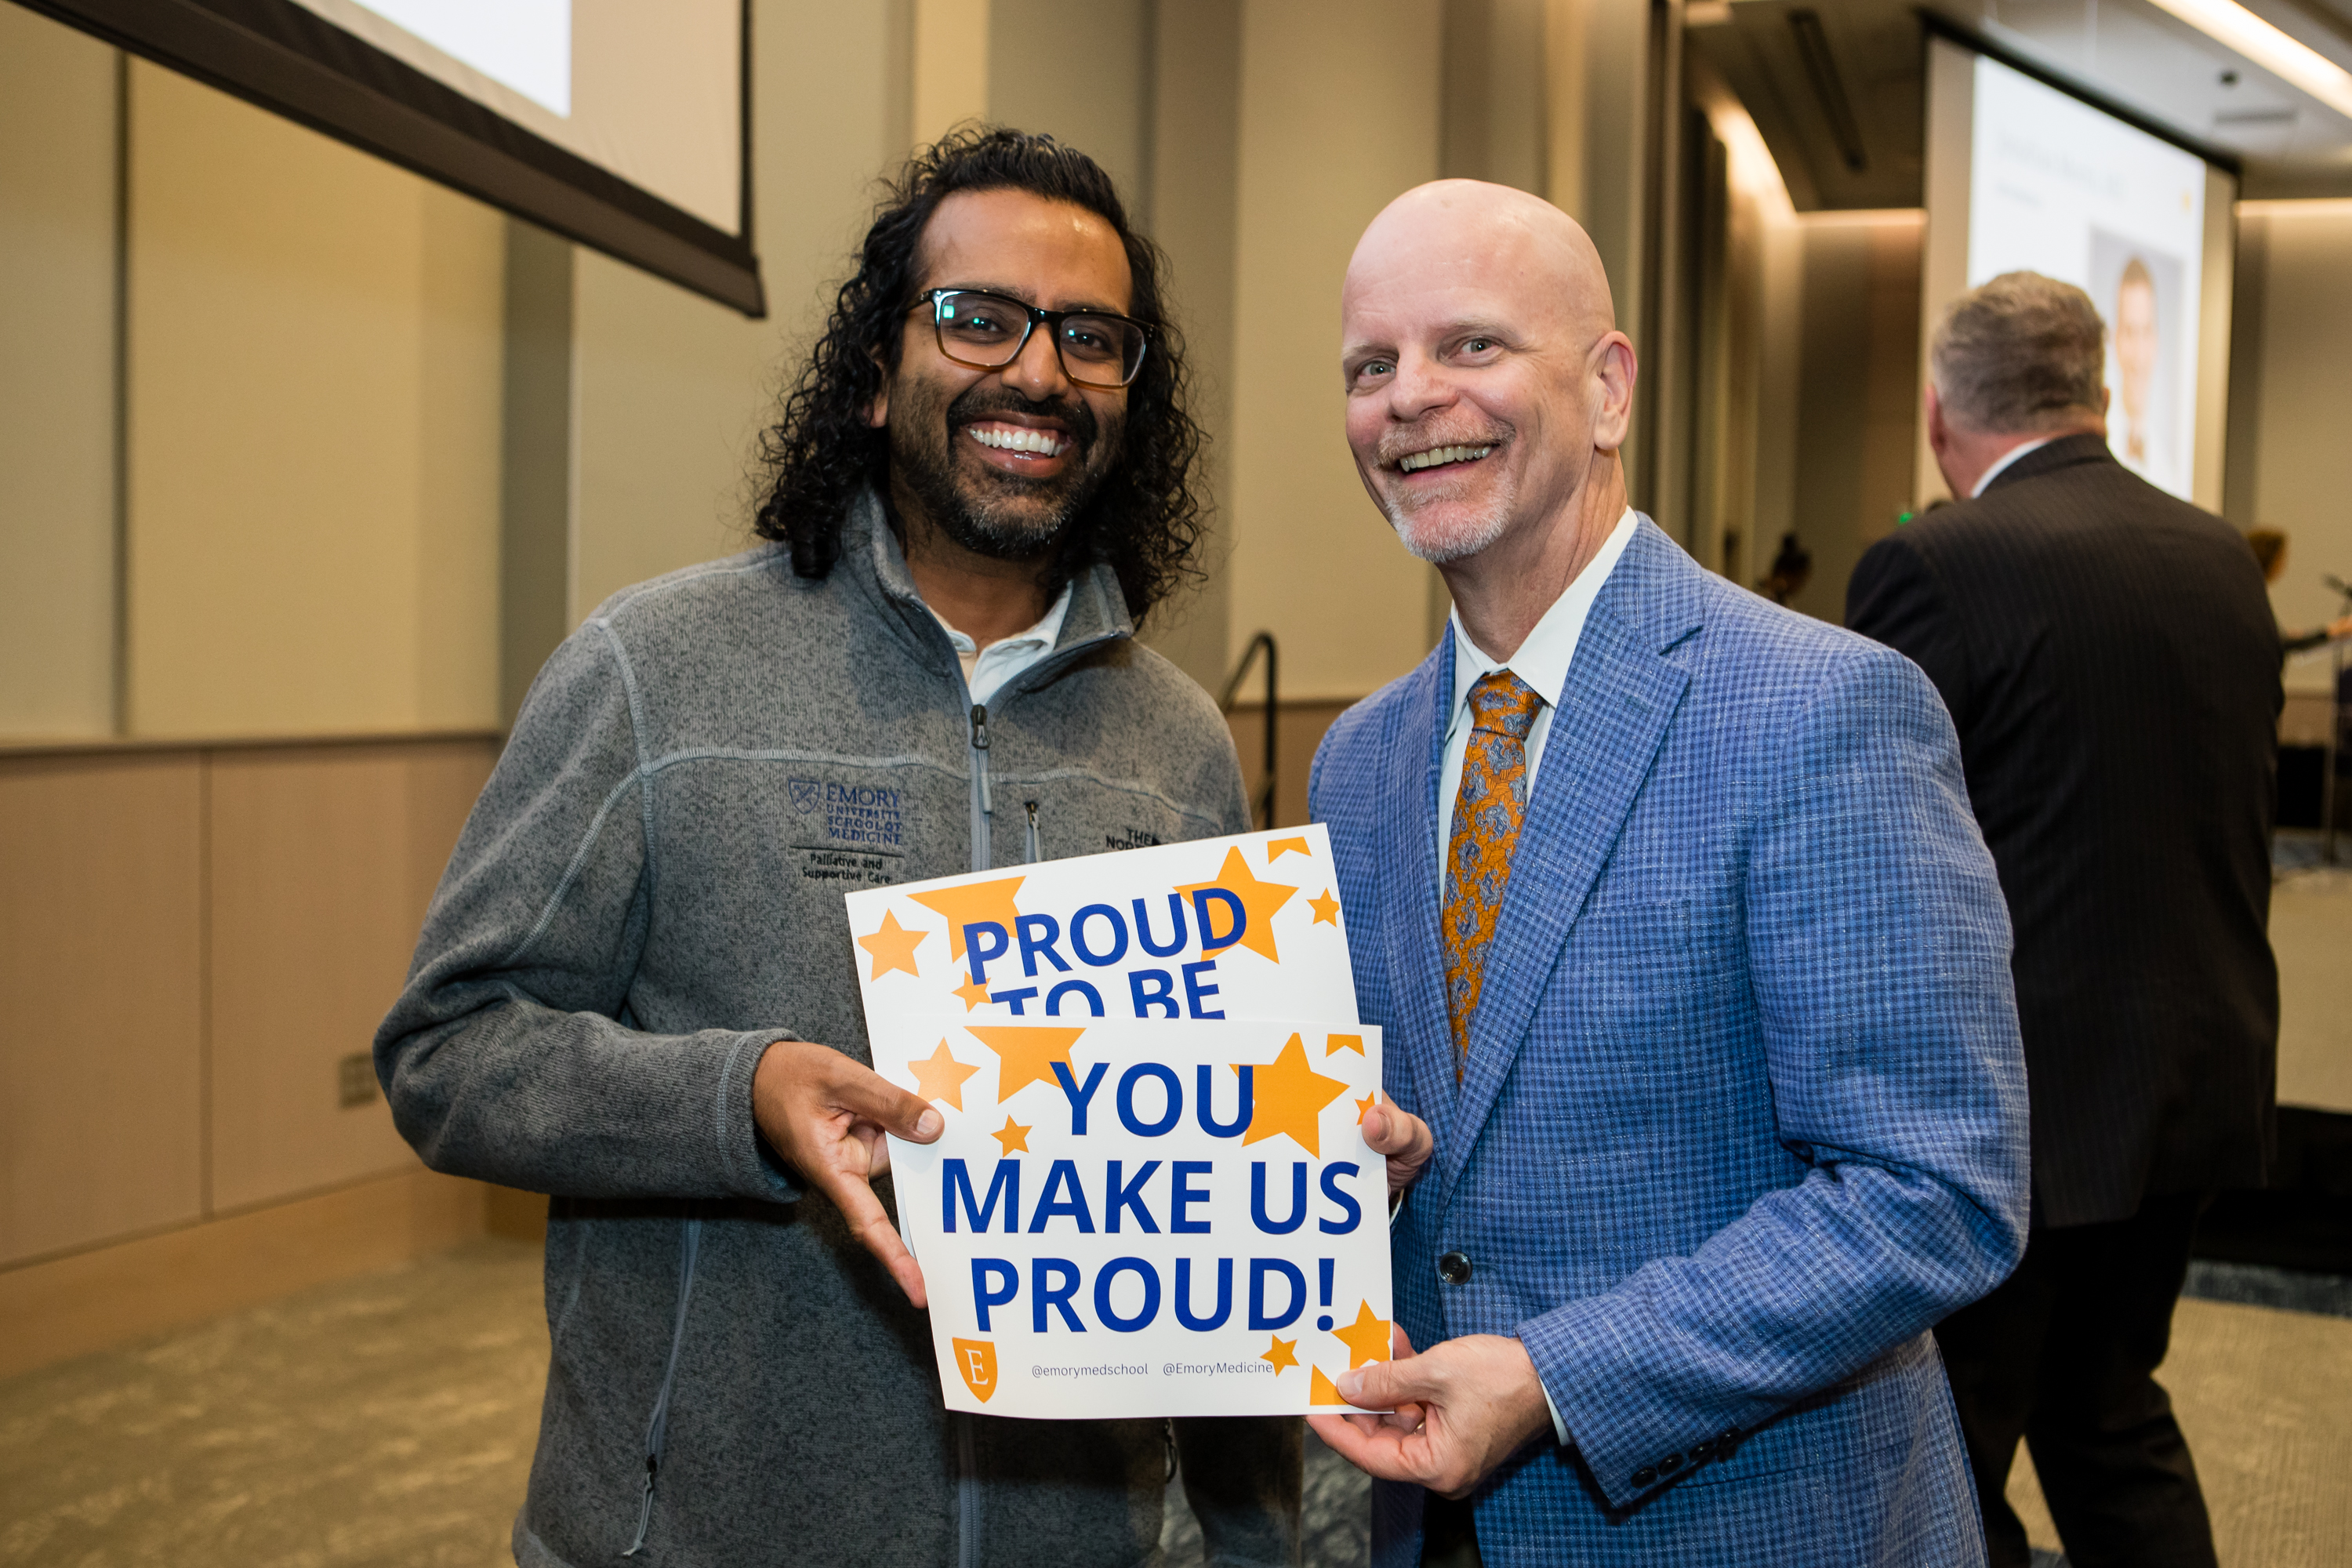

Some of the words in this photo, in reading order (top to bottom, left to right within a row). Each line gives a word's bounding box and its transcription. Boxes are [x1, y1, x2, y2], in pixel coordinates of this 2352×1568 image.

[826, 784, 901, 808] EMORY
[827, 804, 901, 820] UNIVERSITY
[827, 816, 884, 830] SCHOOL
[828, 828, 903, 846] MEDICINE
[1126, 828, 1152, 846] THE
[810, 853, 858, 868] Palliative
[863, 858, 883, 870] and
[802, 866, 862, 882] Supportive
[868, 871, 891, 884] Care
[963, 887, 1247, 986] PROUD
[1127, 959, 1226, 1020] BE
[1049, 1062, 1254, 1138] YOU
[942, 1158, 1214, 1234] MAKE
[1250, 1160, 1363, 1236] US
[971, 1255, 1337, 1334] PROUD!
[964, 1348, 989, 1386] E
[1031, 1362, 1149, 1378] @emorymedschool
[1163, 1361, 1273, 1377] @EmoryMedicine
